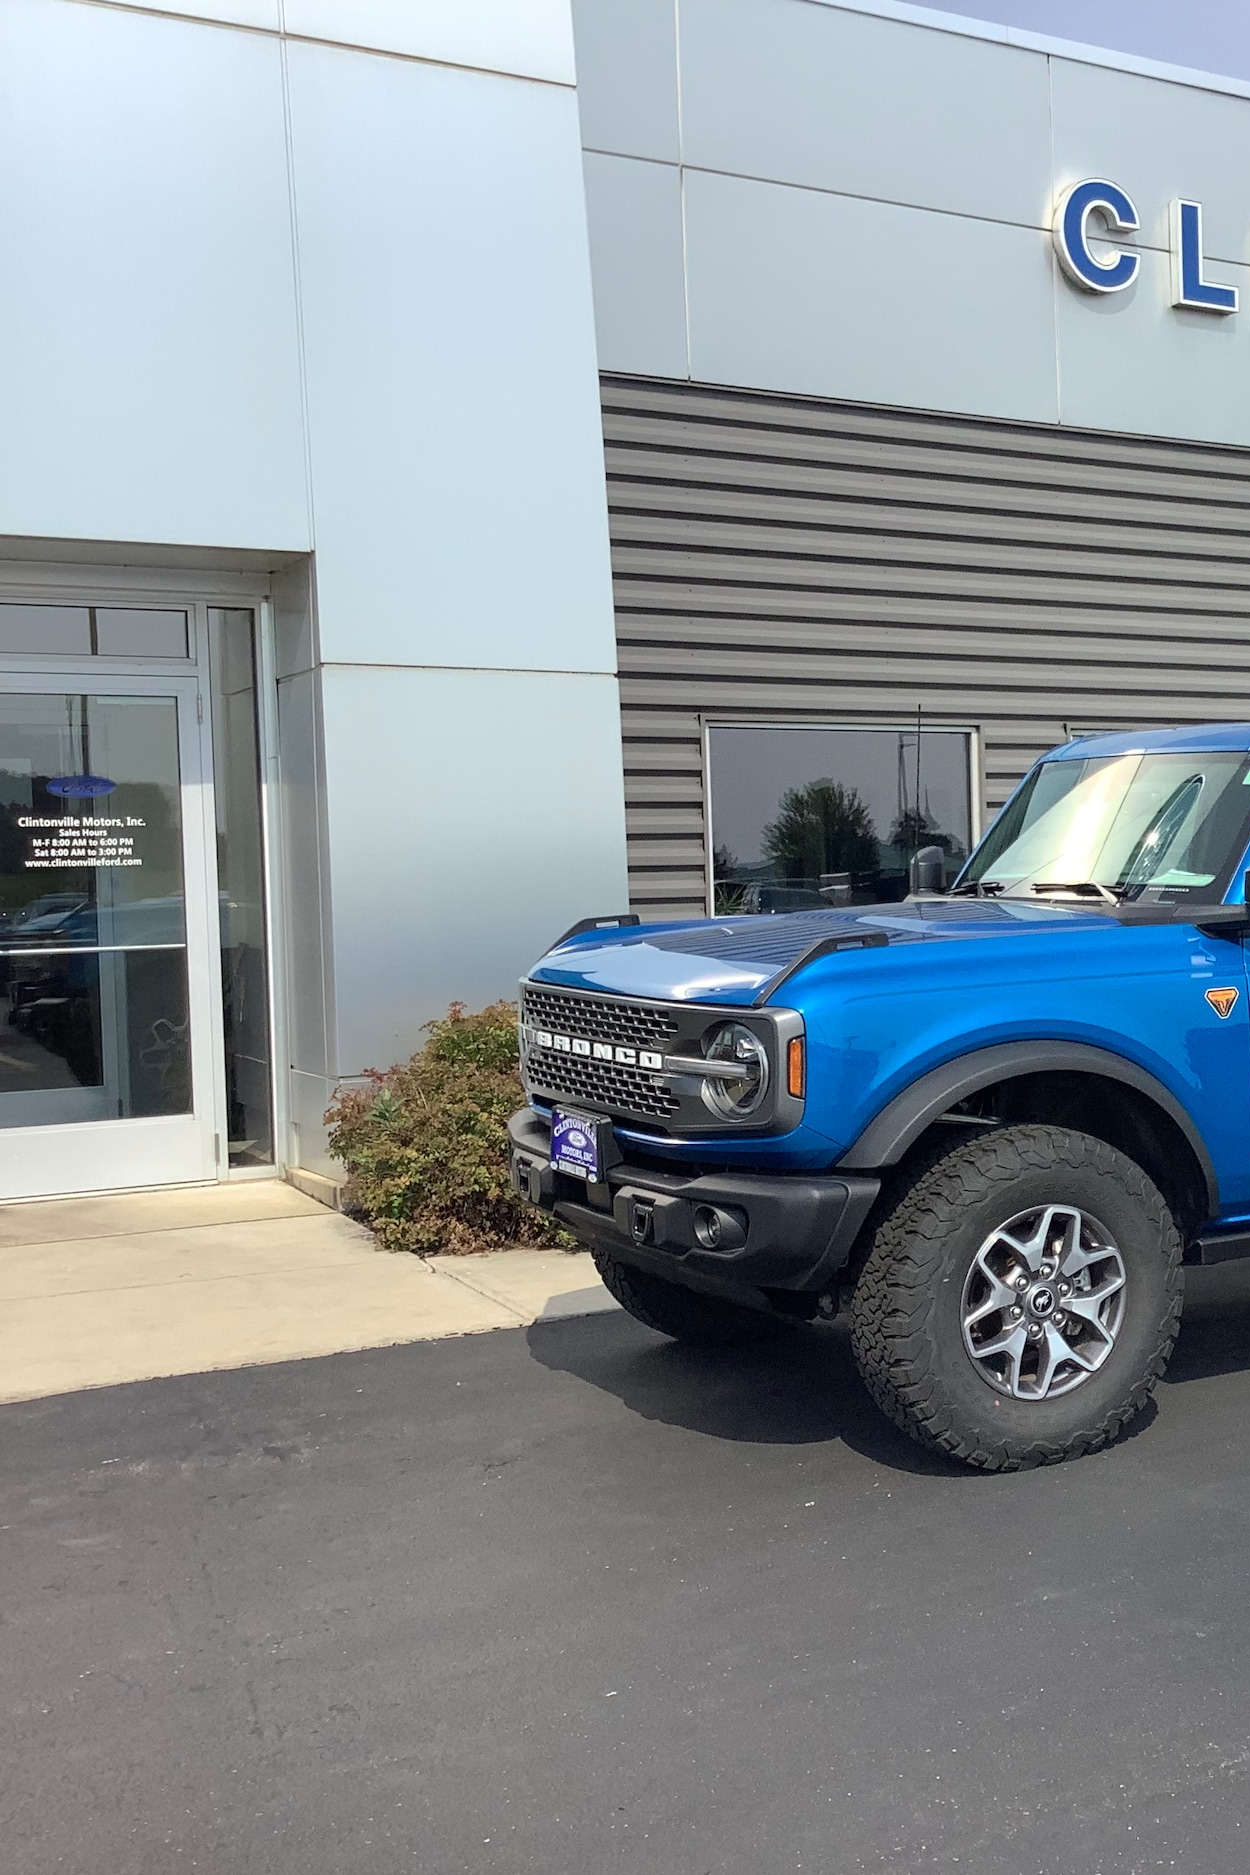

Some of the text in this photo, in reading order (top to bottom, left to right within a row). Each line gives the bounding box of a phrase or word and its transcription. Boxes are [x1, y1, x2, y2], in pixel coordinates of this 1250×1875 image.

[18, 816, 146, 828] Clintonville Motors, Inc.
[59, 828, 107, 837] Sales Hours
[32, 837, 134, 847] M-F 8:00 AM to 6:00 PM
[34, 847, 132, 857] Sat 8:00 AM to 3:00 PM
[25, 858, 143, 868] www.clintonvilleford.com
[536, 1031, 662, 1070] BRONCO
